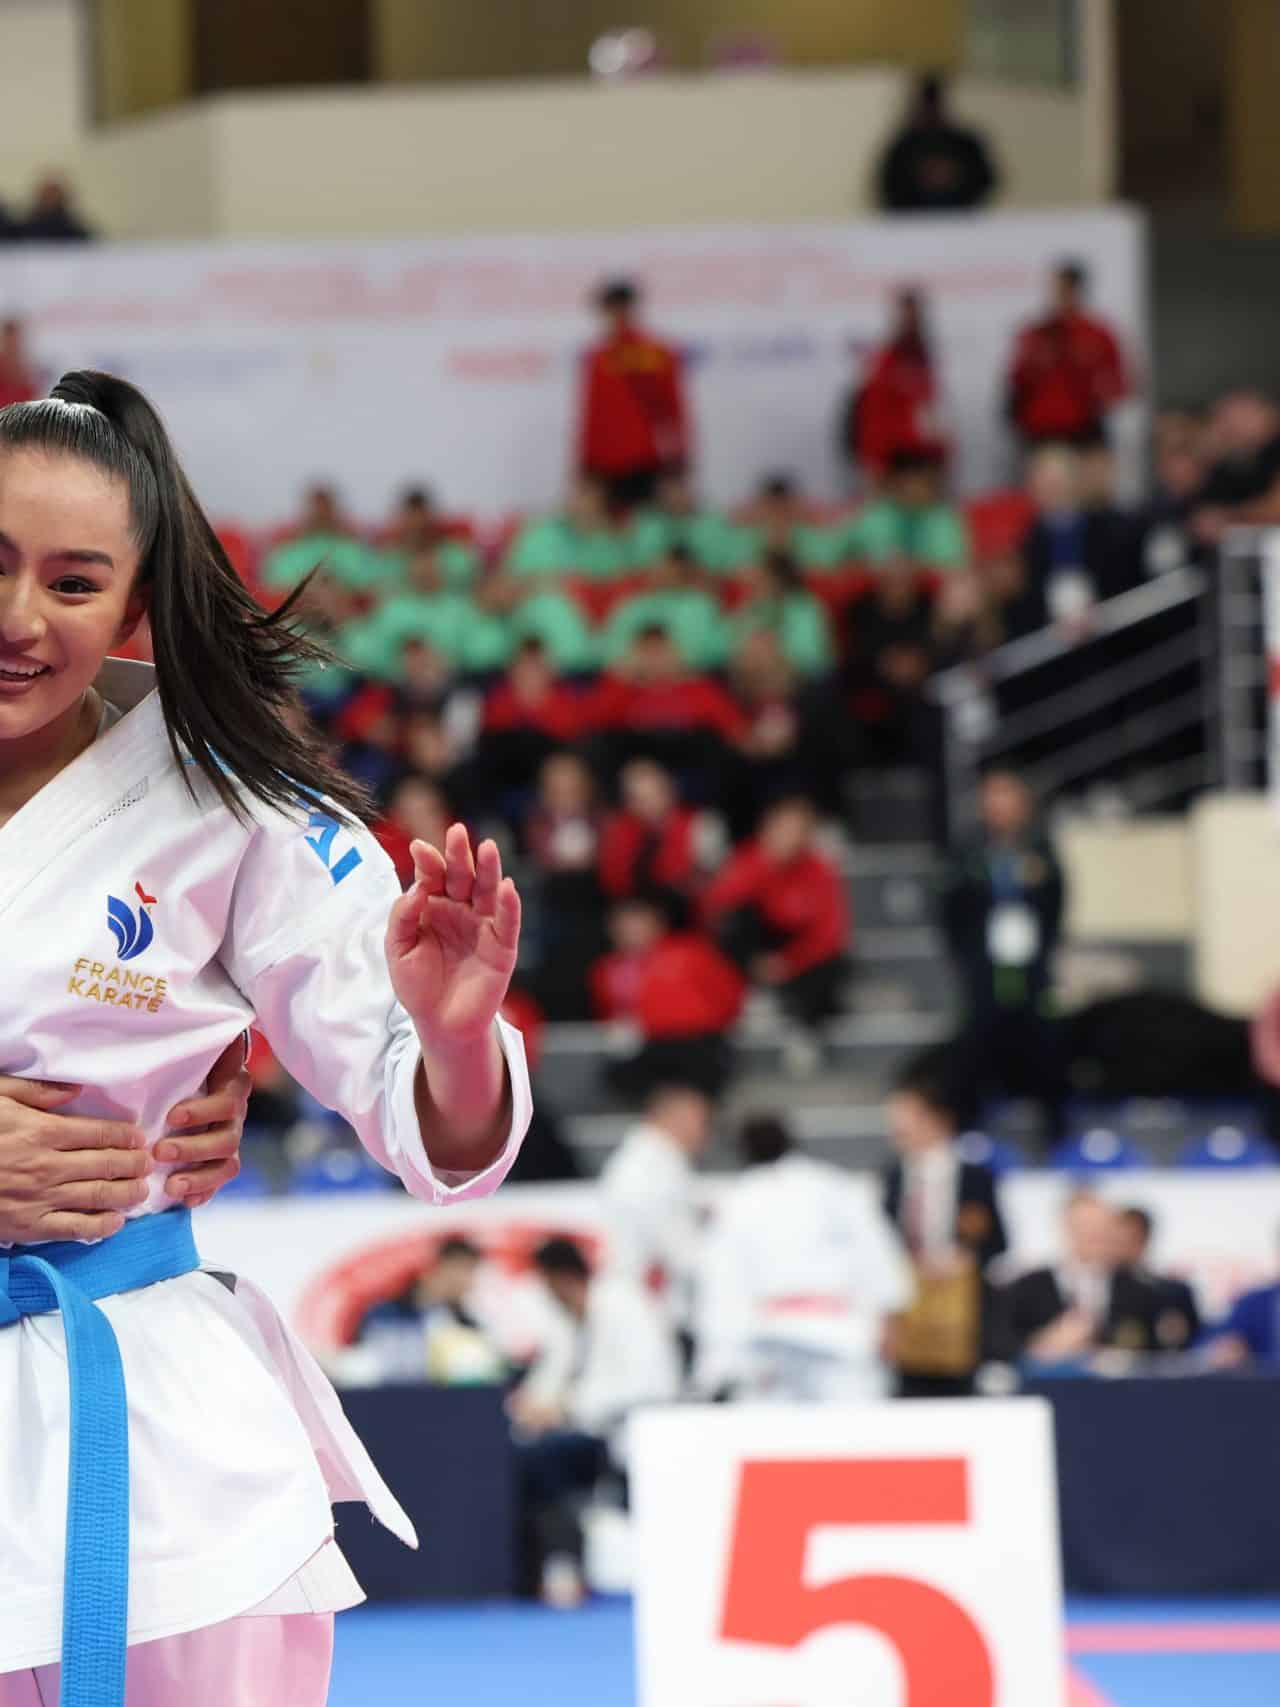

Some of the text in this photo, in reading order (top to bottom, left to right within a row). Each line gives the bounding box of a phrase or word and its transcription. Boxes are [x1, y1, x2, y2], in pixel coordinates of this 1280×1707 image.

[66, 975, 166, 1014] KARATÉ
[73, 957, 168, 993] FRANCE
[719, 1456, 996, 1707] 5
